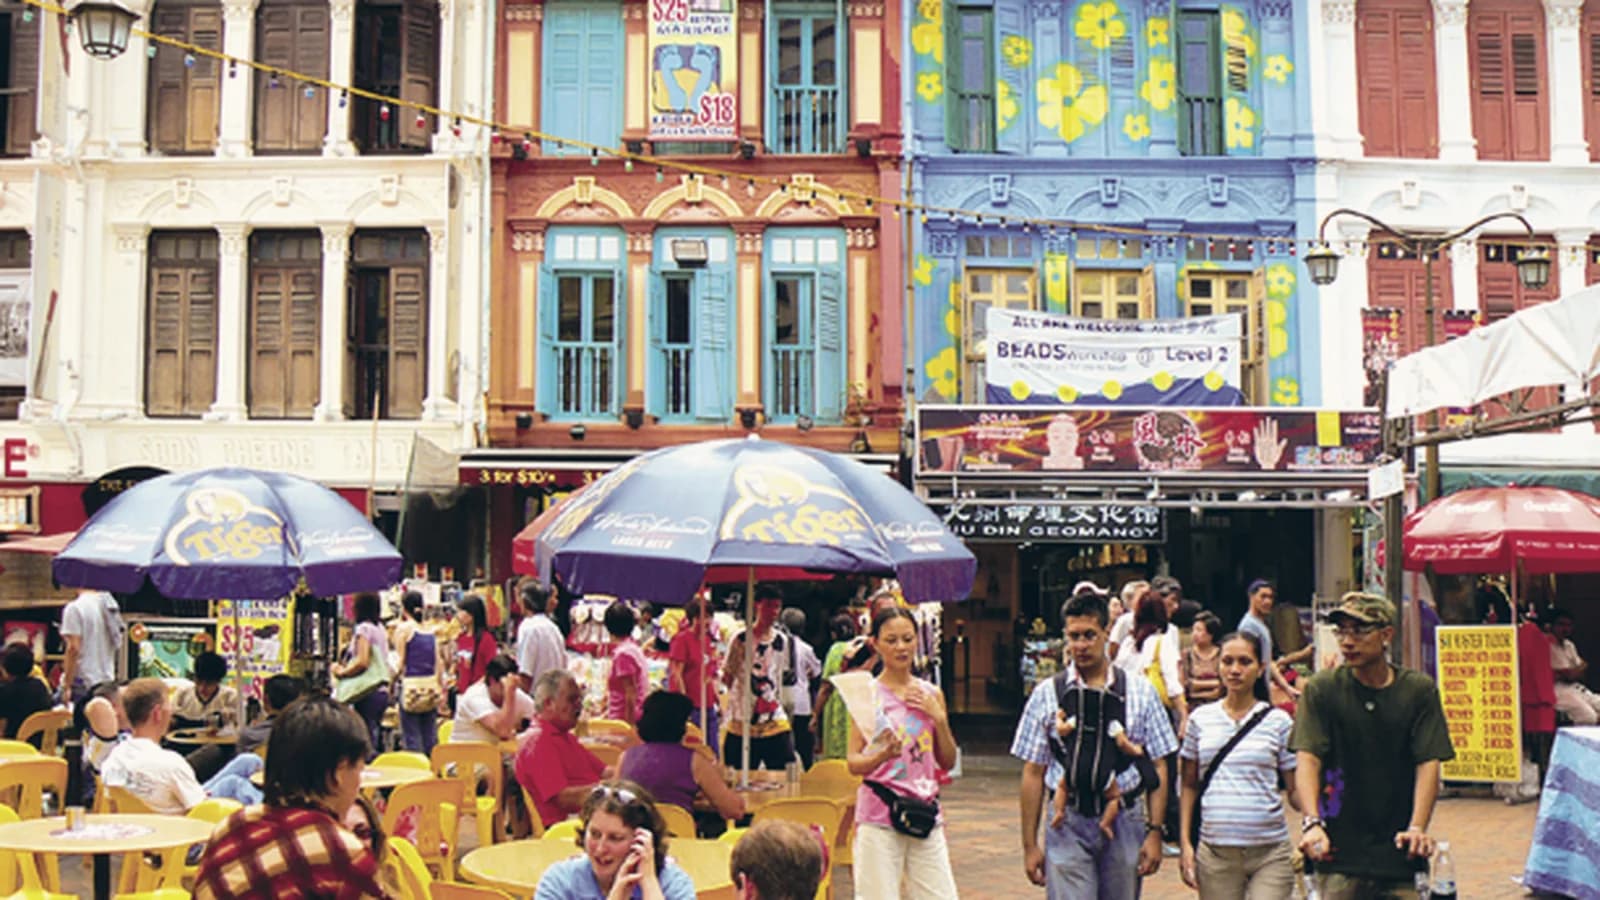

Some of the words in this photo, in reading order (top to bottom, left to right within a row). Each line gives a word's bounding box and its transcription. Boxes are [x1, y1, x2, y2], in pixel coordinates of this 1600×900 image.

[700, 95, 734, 123] $18
[1165, 346, 1214, 362] Level
[1218, 347, 1229, 362] 2
[480, 469, 490, 483] 3
[494, 470, 513, 483] for
[742, 504, 867, 546] Tiger
[951, 525, 976, 535] IU
[983, 525, 1020, 535] DIN
[1029, 526, 1159, 537] GEOMANCY
[183, 520, 284, 559] Tiger
